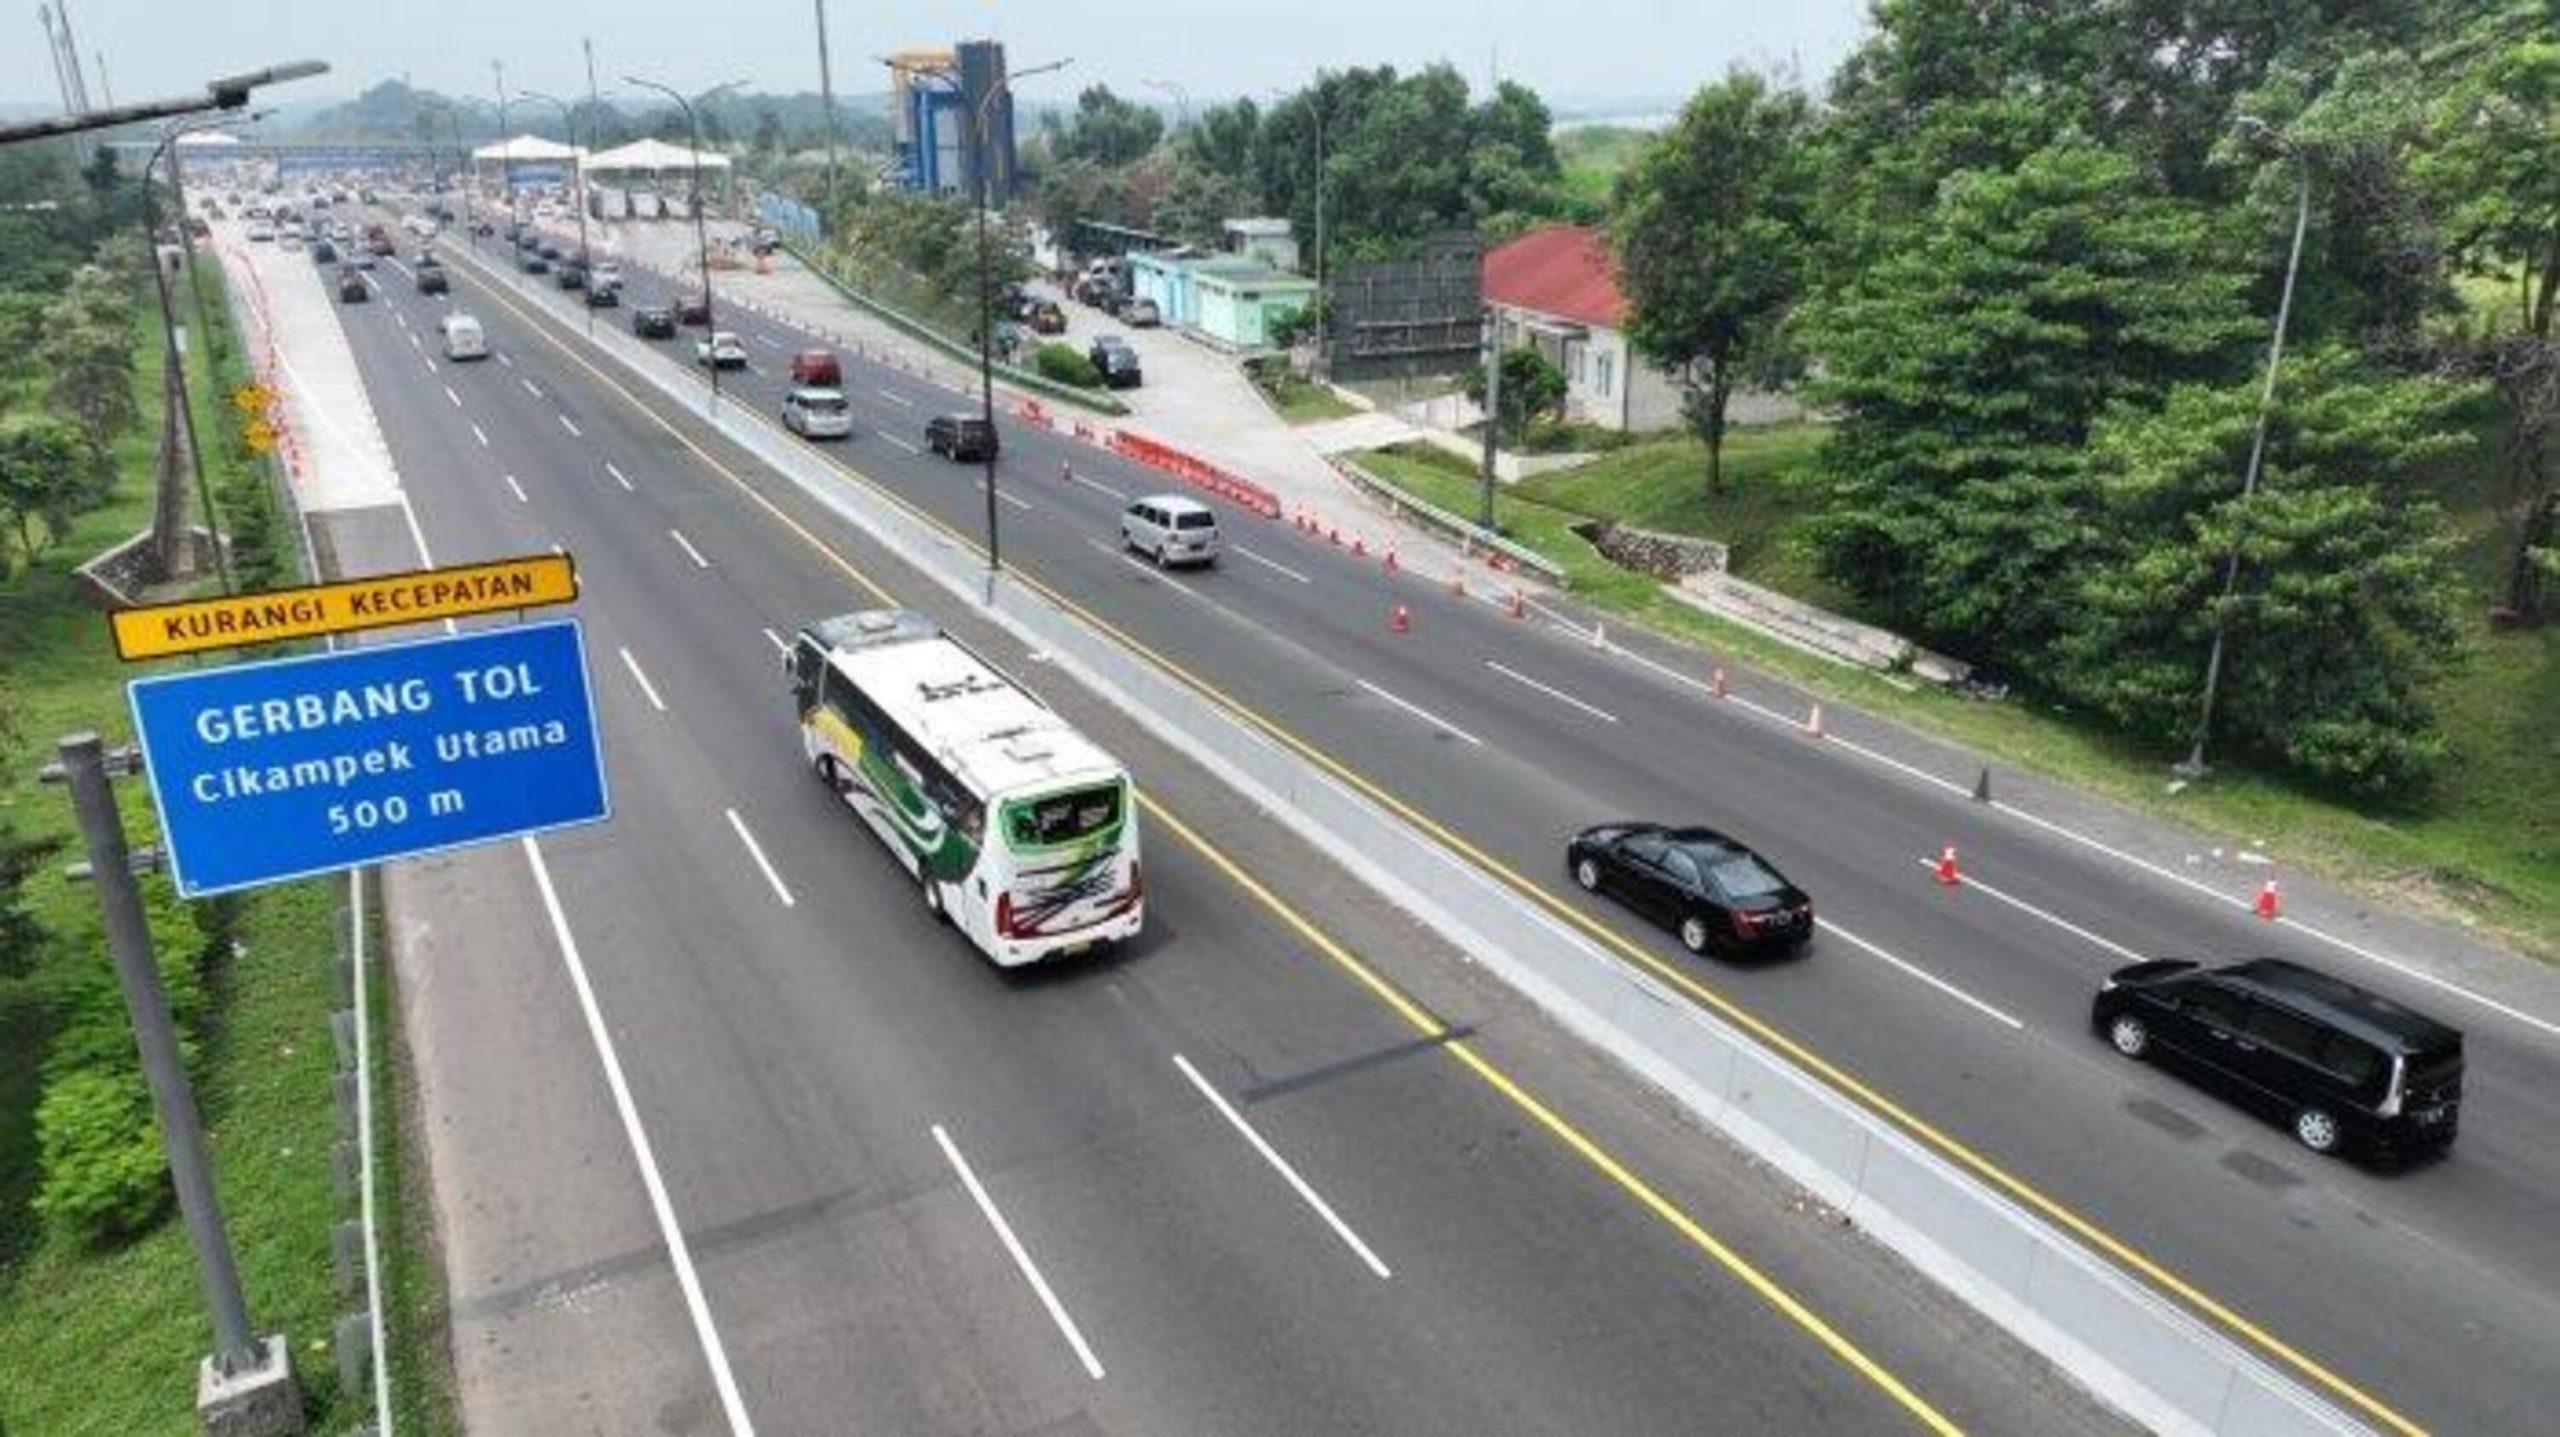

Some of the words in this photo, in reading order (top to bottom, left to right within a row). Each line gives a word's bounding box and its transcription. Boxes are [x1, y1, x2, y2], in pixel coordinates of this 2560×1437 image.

[164, 600, 325, 641] KURANGI
[351, 572, 533, 614] KECEPATAN
[196, 679, 430, 743] GERBANG
[457, 662, 540, 704] TOL
[436, 717, 567, 763] Utama
[328, 795, 408, 835] 500
[430, 786, 463, 816] m
